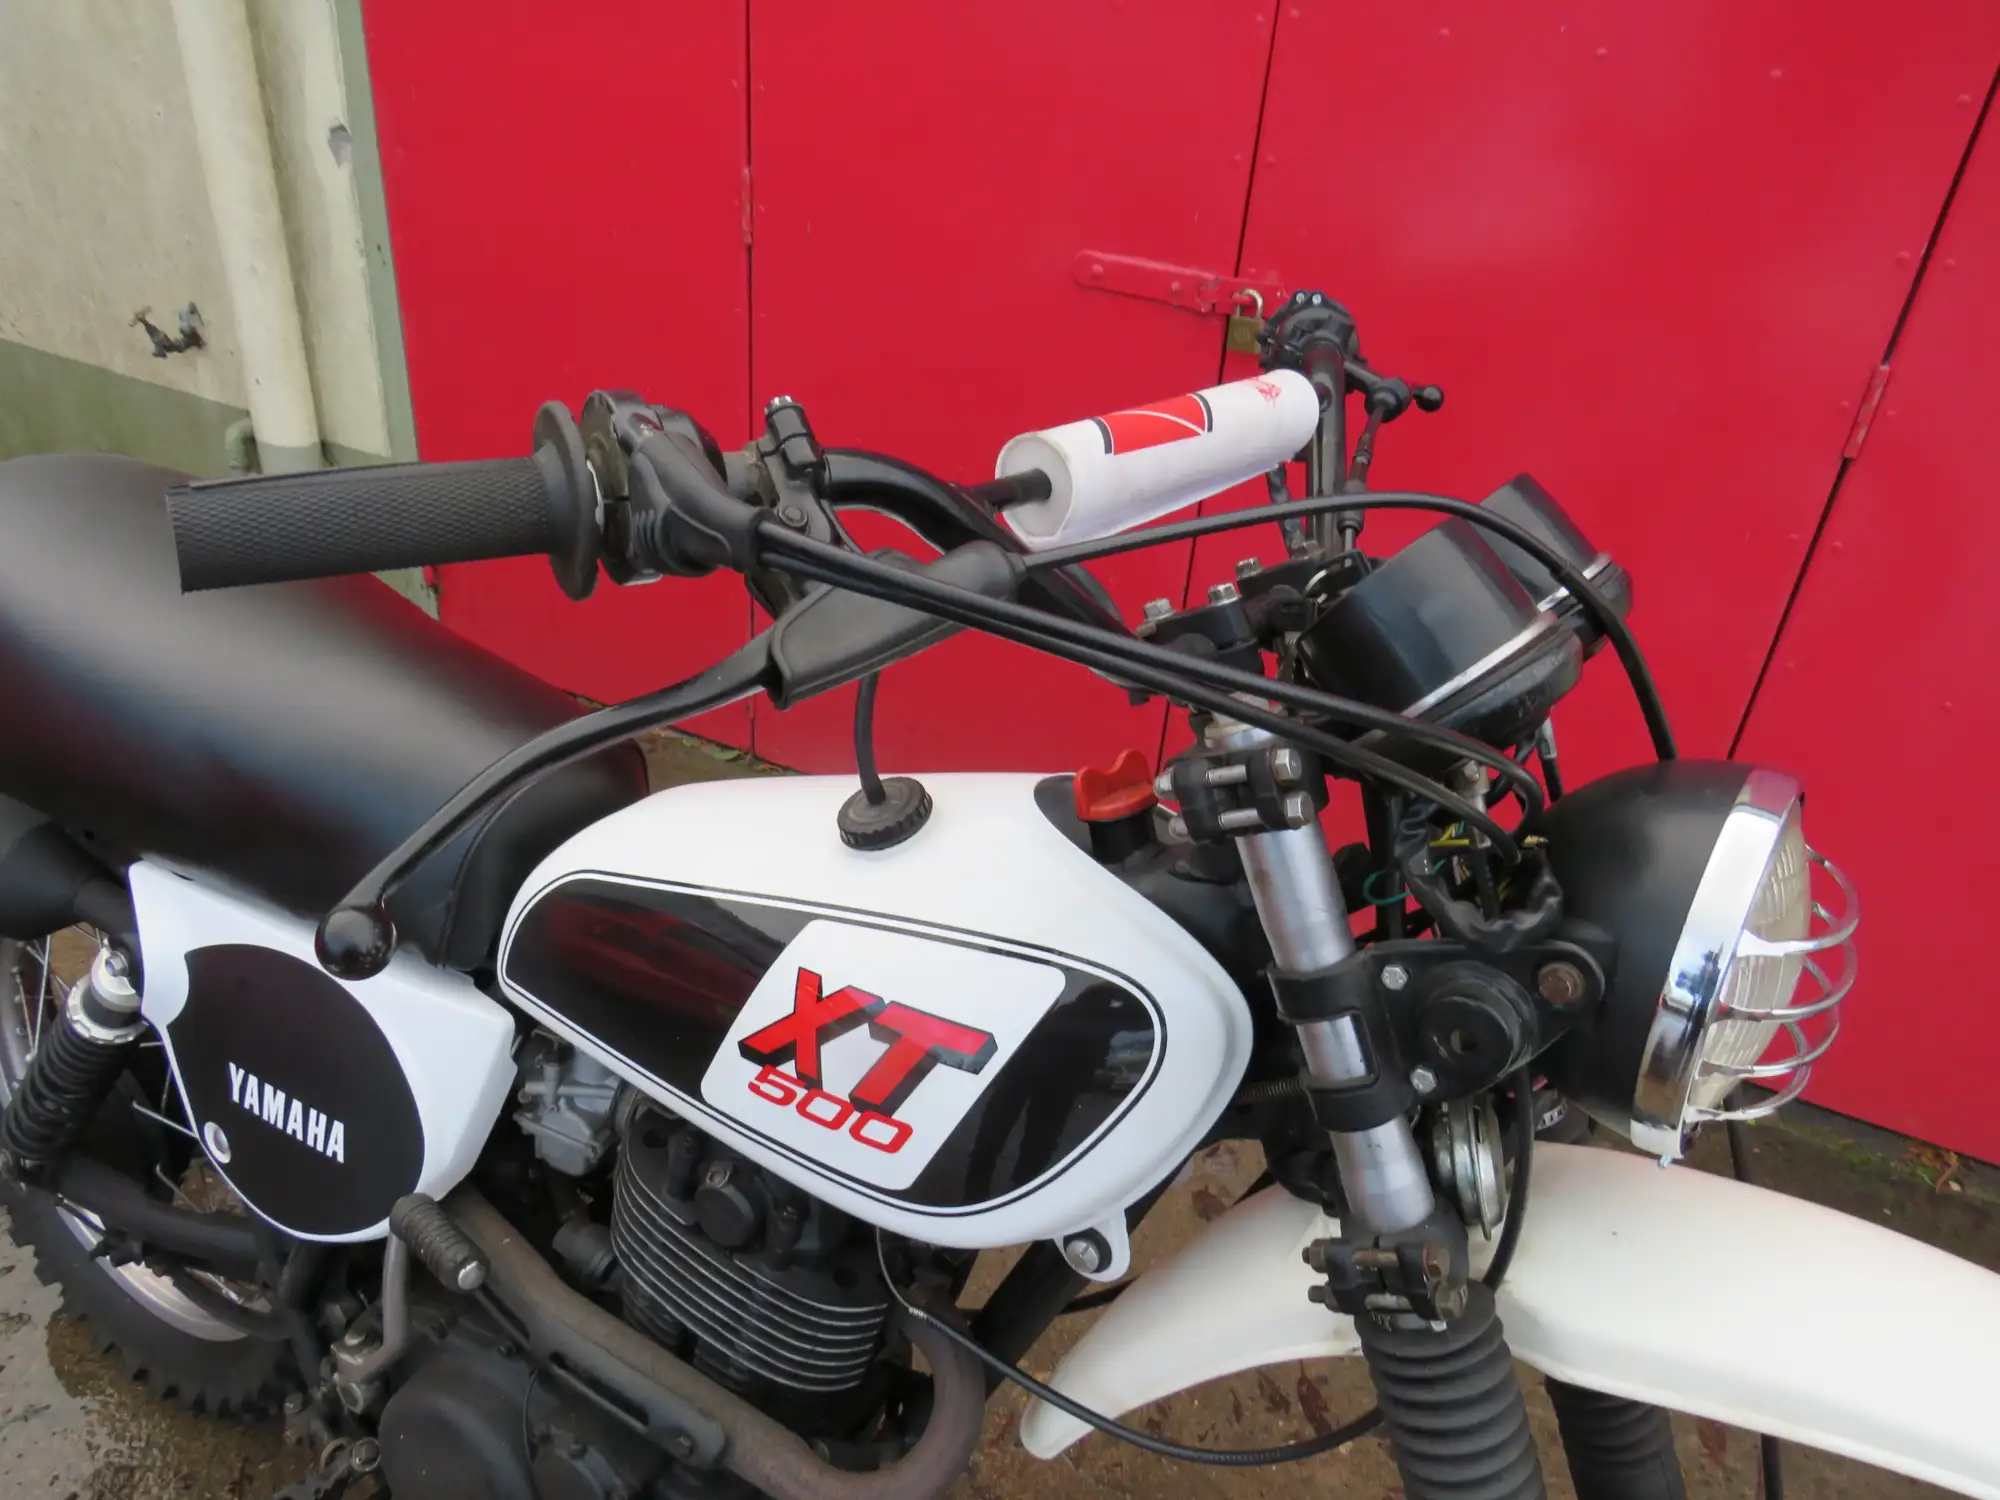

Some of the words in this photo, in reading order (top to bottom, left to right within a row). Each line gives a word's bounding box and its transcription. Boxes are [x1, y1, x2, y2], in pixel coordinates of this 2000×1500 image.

[737, 966, 998, 1118] XT
[228, 1061, 345, 1163] YAMAHA
[747, 1064, 914, 1154] 500
